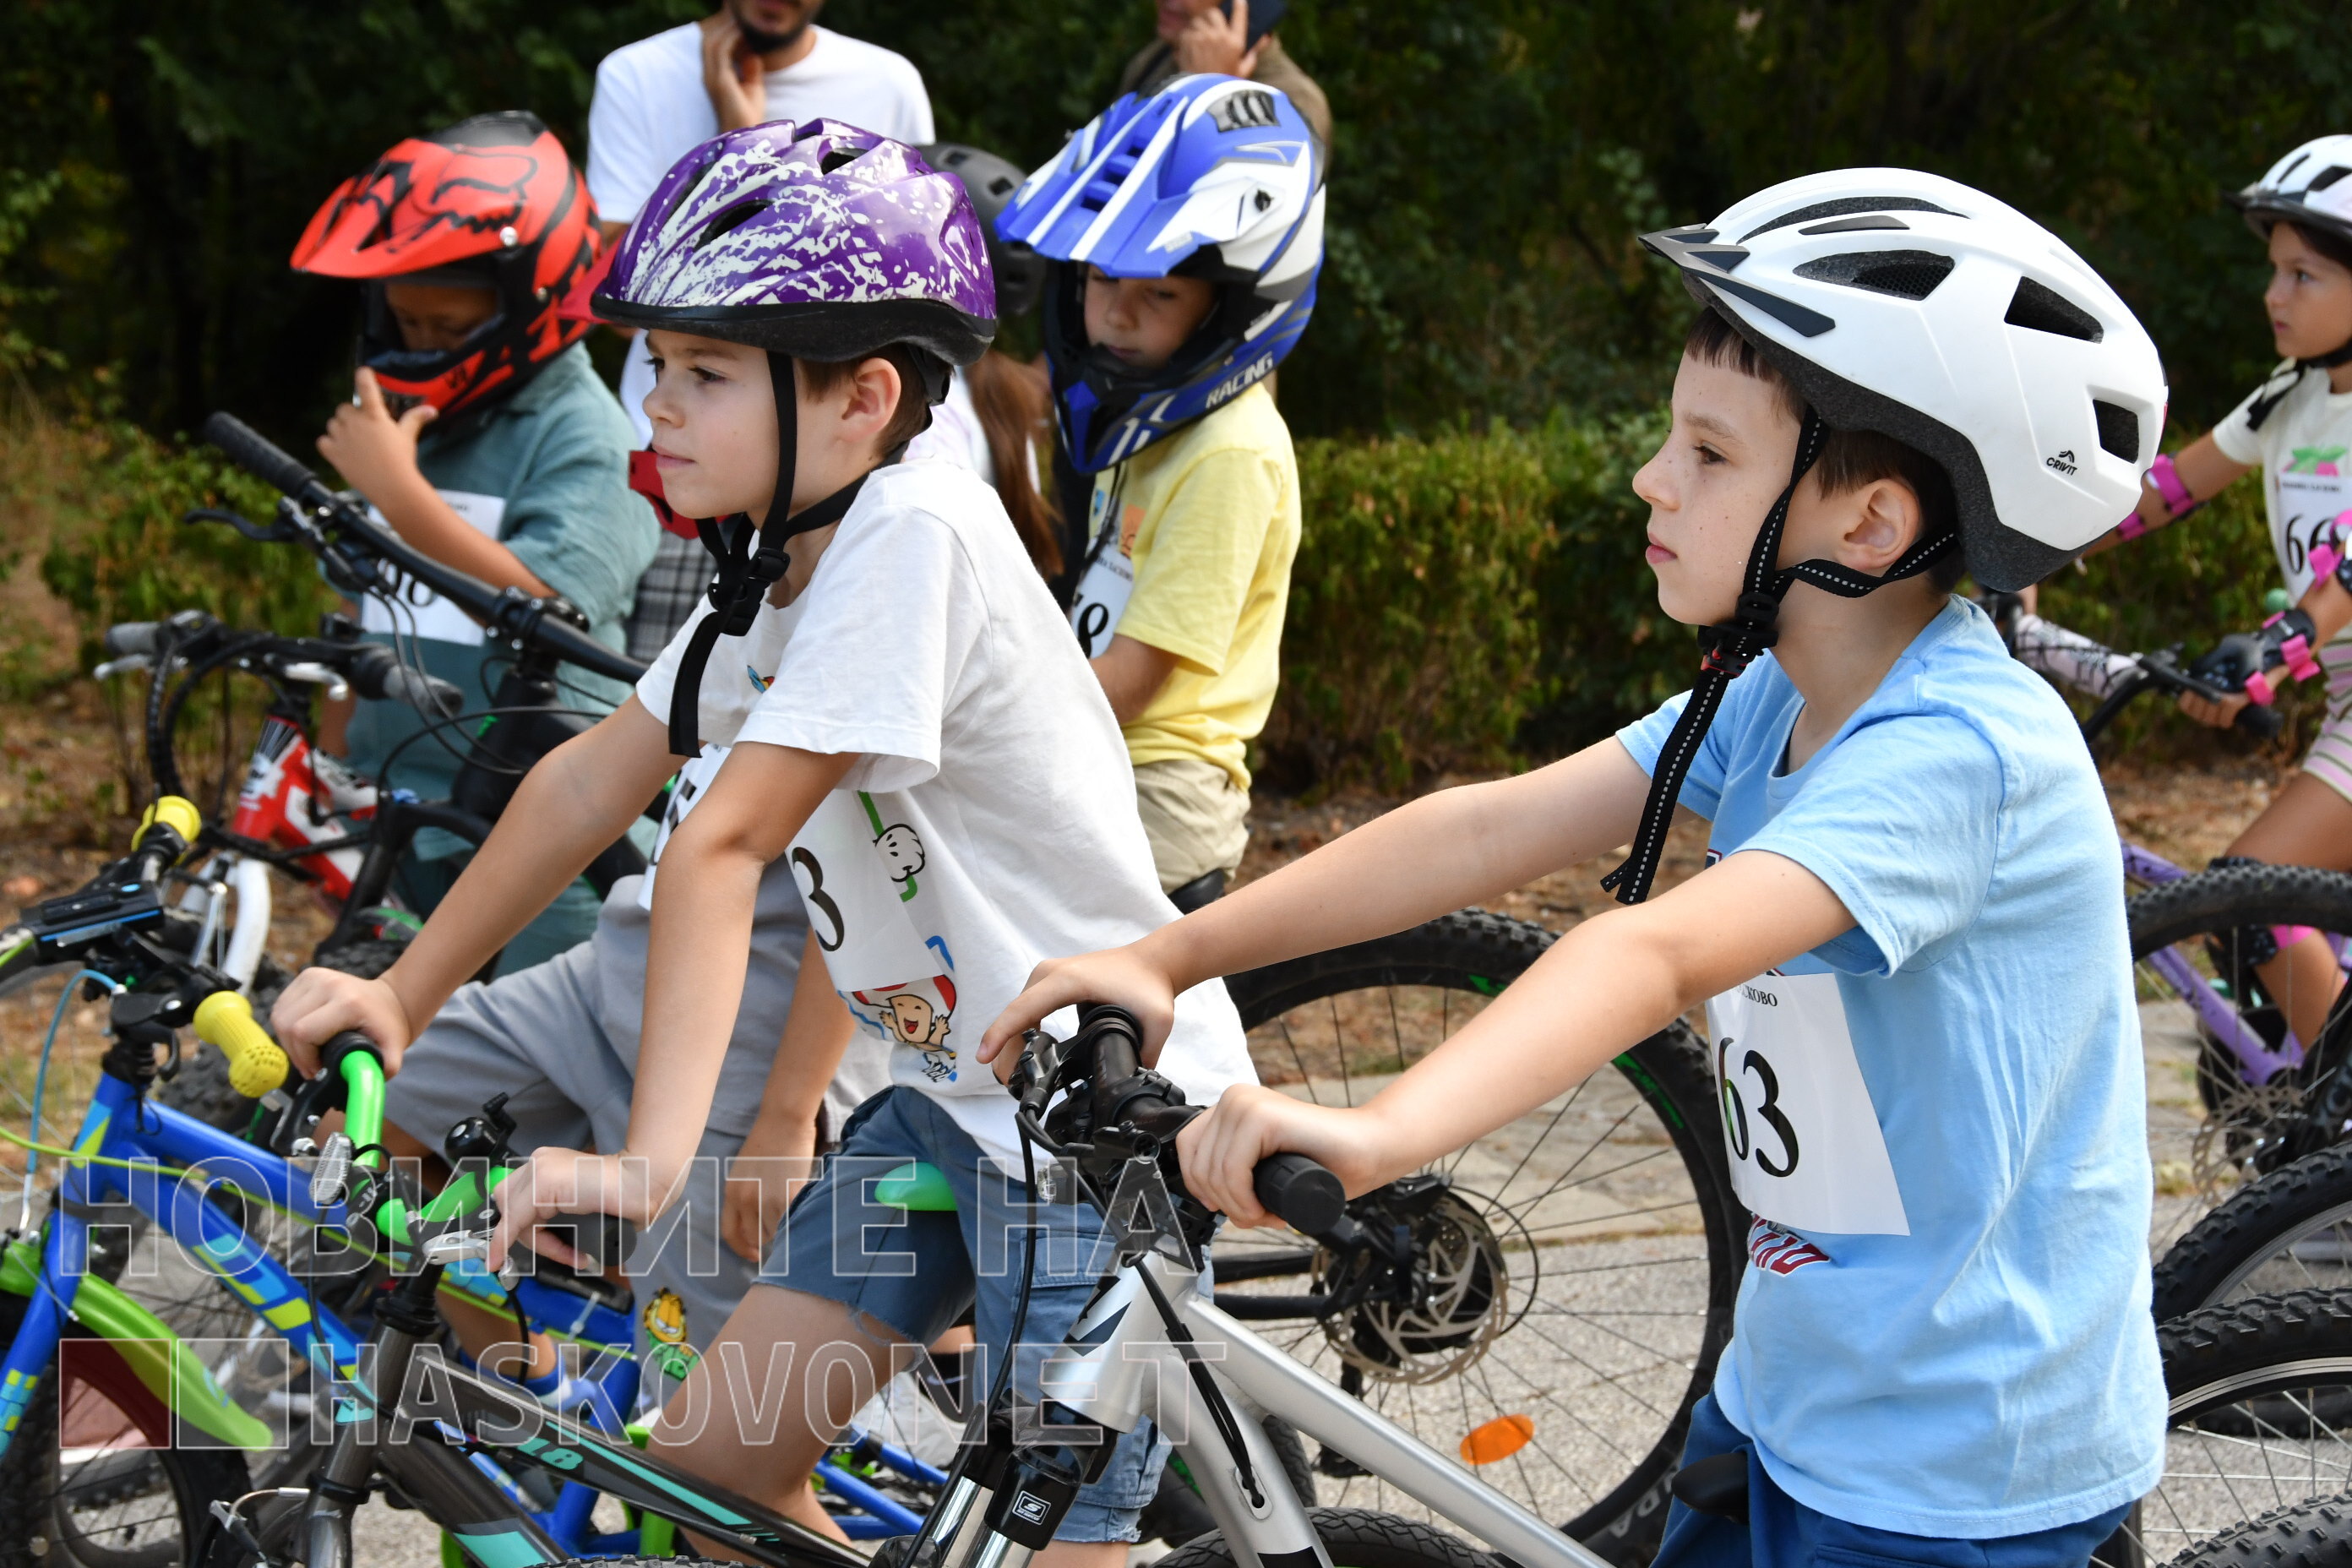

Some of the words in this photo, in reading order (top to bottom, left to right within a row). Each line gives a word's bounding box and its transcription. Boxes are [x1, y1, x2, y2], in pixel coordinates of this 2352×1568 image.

[1206, 351, 1273, 409] RACING
[2046, 457, 2077, 476] CRIVIT
[1718, 1037, 1799, 1178] 63
